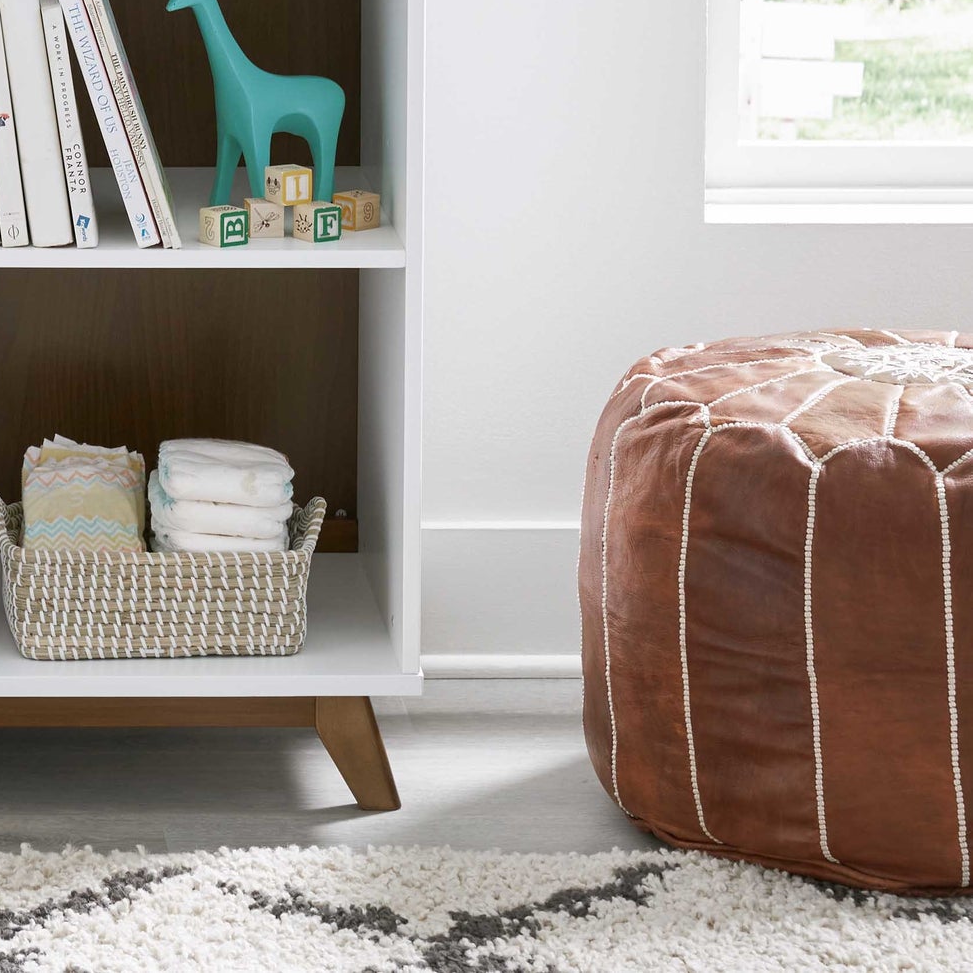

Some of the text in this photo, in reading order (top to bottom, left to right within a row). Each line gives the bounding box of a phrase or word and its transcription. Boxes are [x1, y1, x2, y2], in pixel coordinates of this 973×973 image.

[53, 35, 62, 61] WORK
[67, 2, 117, 134] THE WIZARD OF US
[58, 67, 64, 76] IN
[60, 82, 71, 128] PROGRESS
[110, 53, 147, 151] THE PAINTBRUSH BUNNY
[111, 78, 121, 95] SAY
[127, 127, 145, 168] VANESSA
[64, 147, 77, 192] FRANTA
[72, 143, 86, 193] CONNOR
[109, 147, 132, 200] HOUSTON
[122, 158, 137, 184] JEAN
[225, 217, 244, 240] B
[320, 213, 337, 237] F
